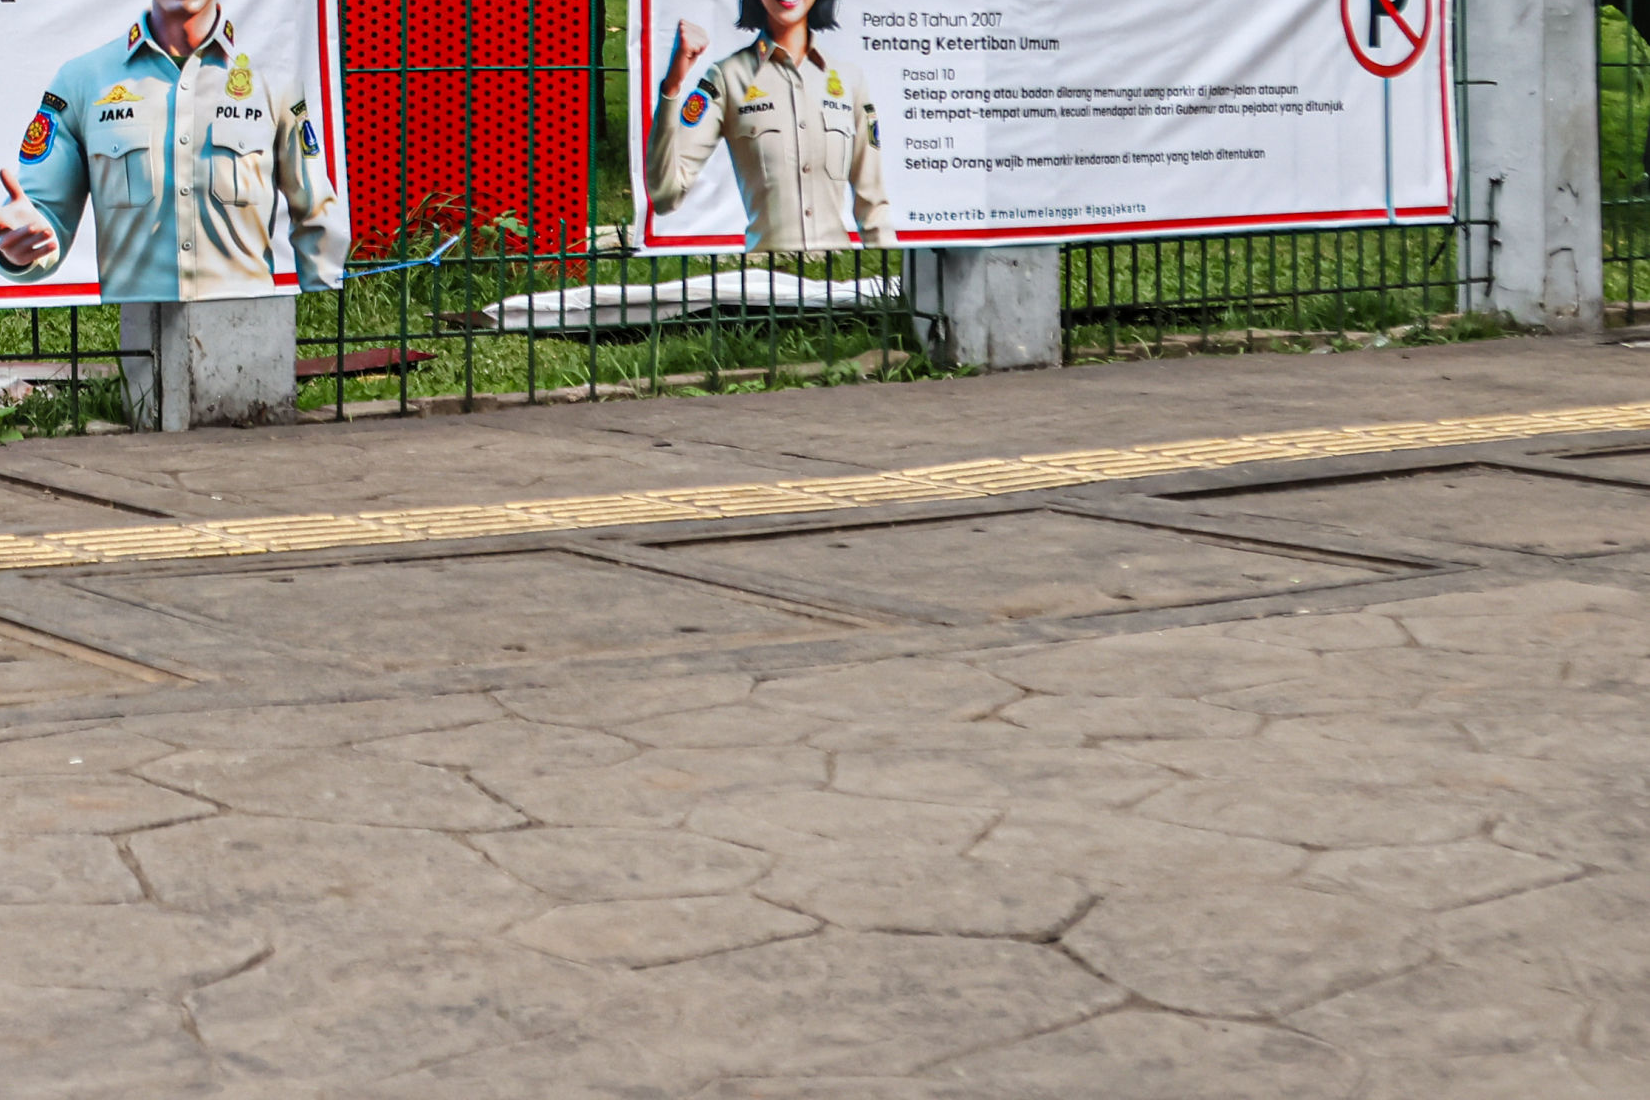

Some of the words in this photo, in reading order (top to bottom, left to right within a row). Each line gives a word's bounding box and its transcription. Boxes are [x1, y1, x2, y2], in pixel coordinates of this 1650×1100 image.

[863, 13, 905, 27] Perda
[908, 12, 918, 27] 8
[921, 13, 967, 27] Tahun
[971, 12, 1002, 27] 2007
[862, 36, 930, 55] Tentang
[936, 35, 1016, 50] Ketertiban
[1020, 37, 1059, 50] Umum
[902, 69, 938, 80] Pasal
[942, 68, 955, 80] 10
[904, 88, 947, 103] Setiap
[951, 90, 991, 103] orang
[993, 88, 1018, 99] atau
[1021, 87, 1054, 98] badan
[1167, 85, 1196, 101] parkir
[1198, 85, 1207, 97] di
[1258, 85, 1298, 97] ataupun
[823, 100, 839, 109] POL
[904, 107, 918, 120] di
[921, 107, 1021, 122] tempat-tempat
[1060, 106, 1090, 117] kecuali
[1154, 104, 1174, 115] dari
[1218, 104, 1239, 113] atau
[1242, 102, 1278, 116] pejabat
[1280, 103, 1303, 115] yang
[1305, 101, 1343, 114] ditunjuk
[99, 107, 136, 123] JAKA
[216, 106, 240, 118] POL
[245, 108, 262, 121] PP
[906, 138, 941, 149] Pasal
[944, 137, 953, 148] 11
[905, 158, 948, 172] Setiap
[952, 157, 992, 172] Orang
[995, 155, 1023, 170] wajib
[1027, 155, 1073, 166] memarkir
[1075, 154, 1120, 165] kendaraan
[1122, 152, 1132, 164] di
[1132, 153, 1165, 167] tempat
[1166, 153, 1189, 165] yang
[1191, 150, 1214, 161] telah
[1216, 149, 1265, 160] ditentukan
[909, 209, 985, 224] #ayotertib
[990, 207, 1082, 219] #malumelanggar
[1086, 204, 1145, 217] #jagajakarta
